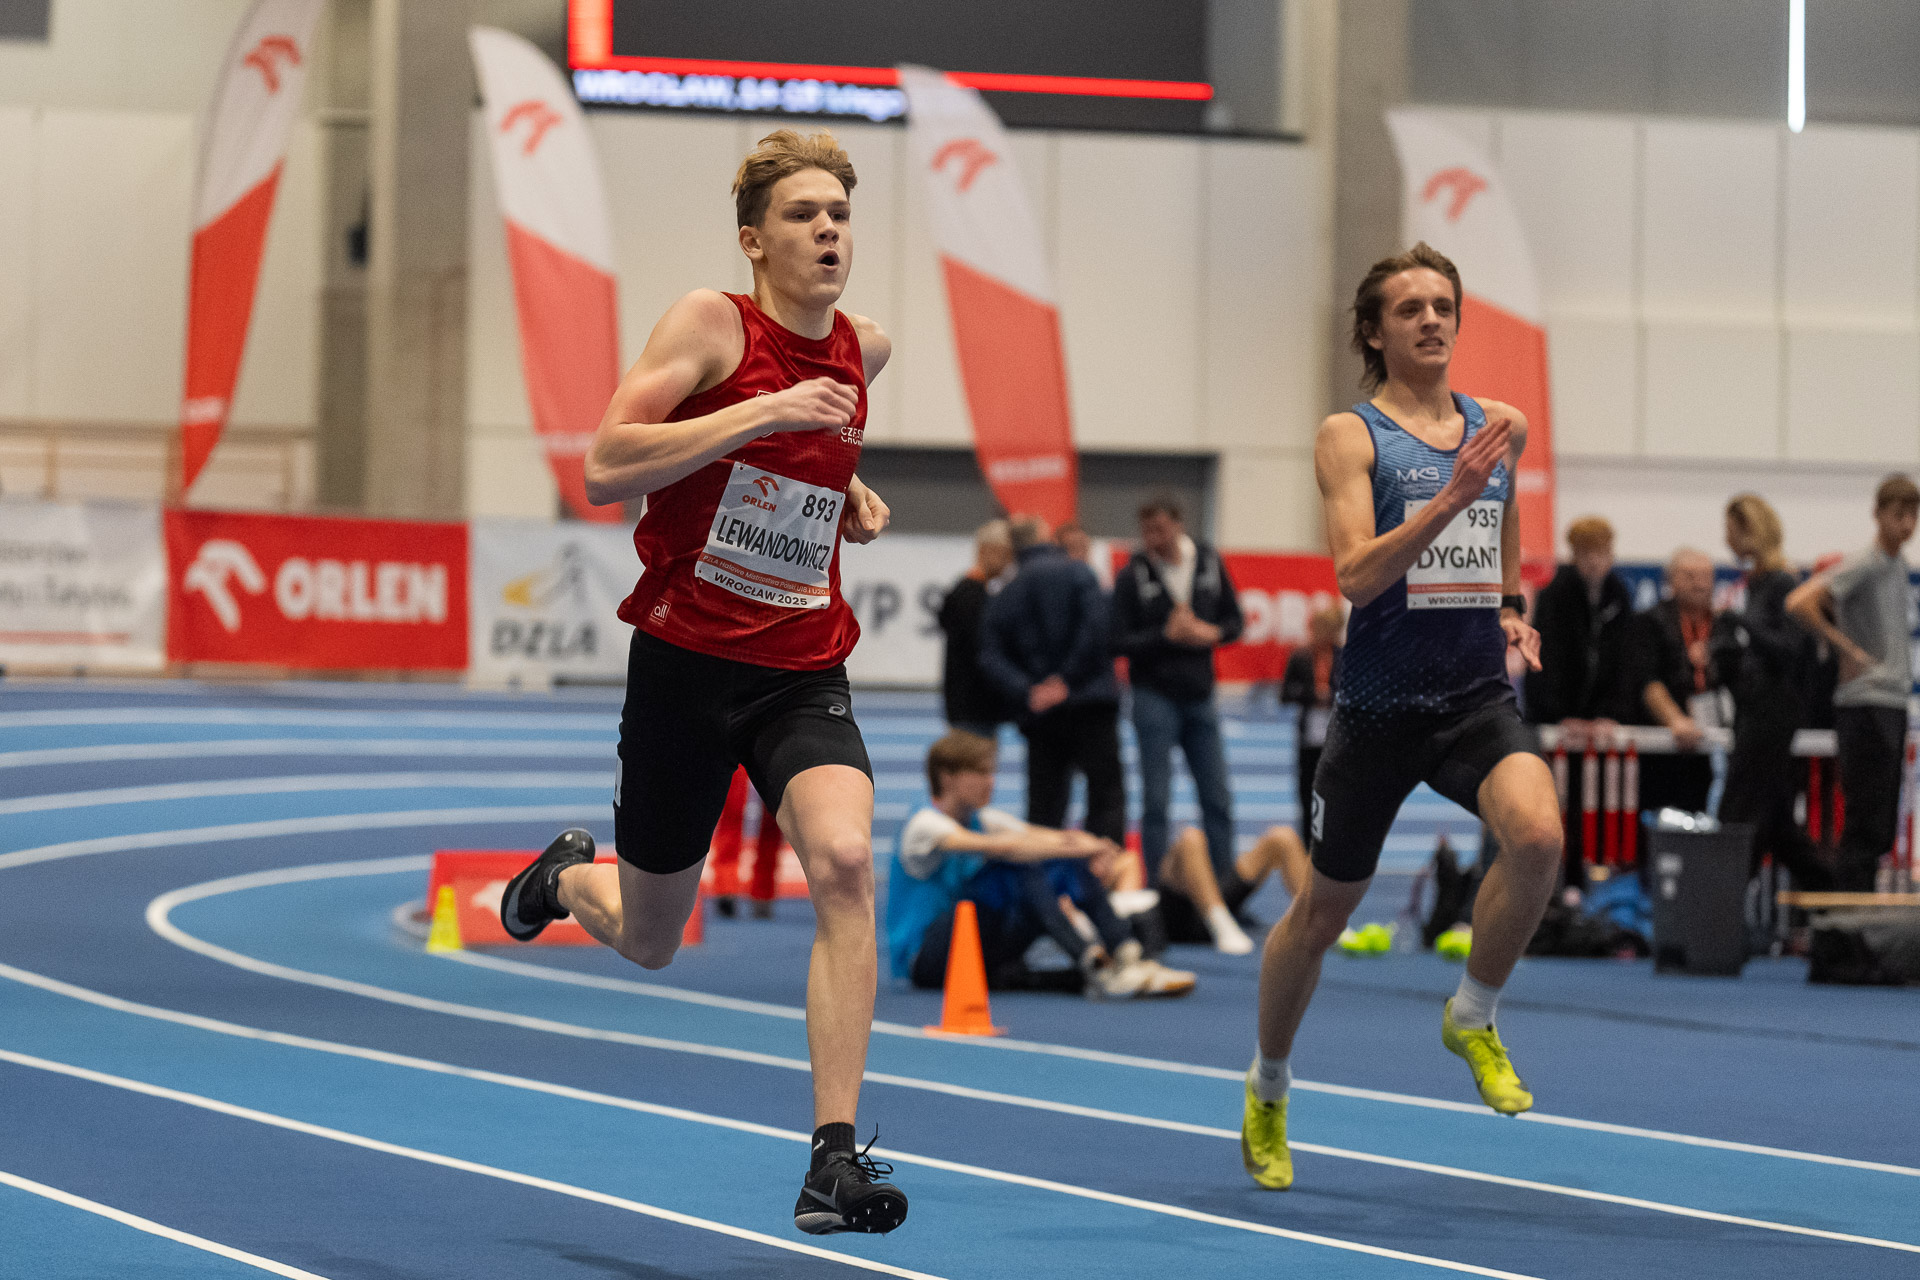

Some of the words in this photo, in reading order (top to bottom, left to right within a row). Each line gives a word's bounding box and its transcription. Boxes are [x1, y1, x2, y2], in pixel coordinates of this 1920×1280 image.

[1396, 466, 1440, 481] MKS
[742, 494, 777, 513] ORLEN
[801, 493, 837, 523] 893
[1467, 508, 1498, 528] 935
[716, 515, 831, 572] LEWANDOWICZ
[702, 555, 719, 565] PZLA
[720, 561, 745, 576] Halowe
[1417, 545, 1498, 569] DYGANT
[275, 557, 447, 625] ORLEN
[714, 572, 776, 601] WROCŁAW
[777, 593, 808, 606] 2025
